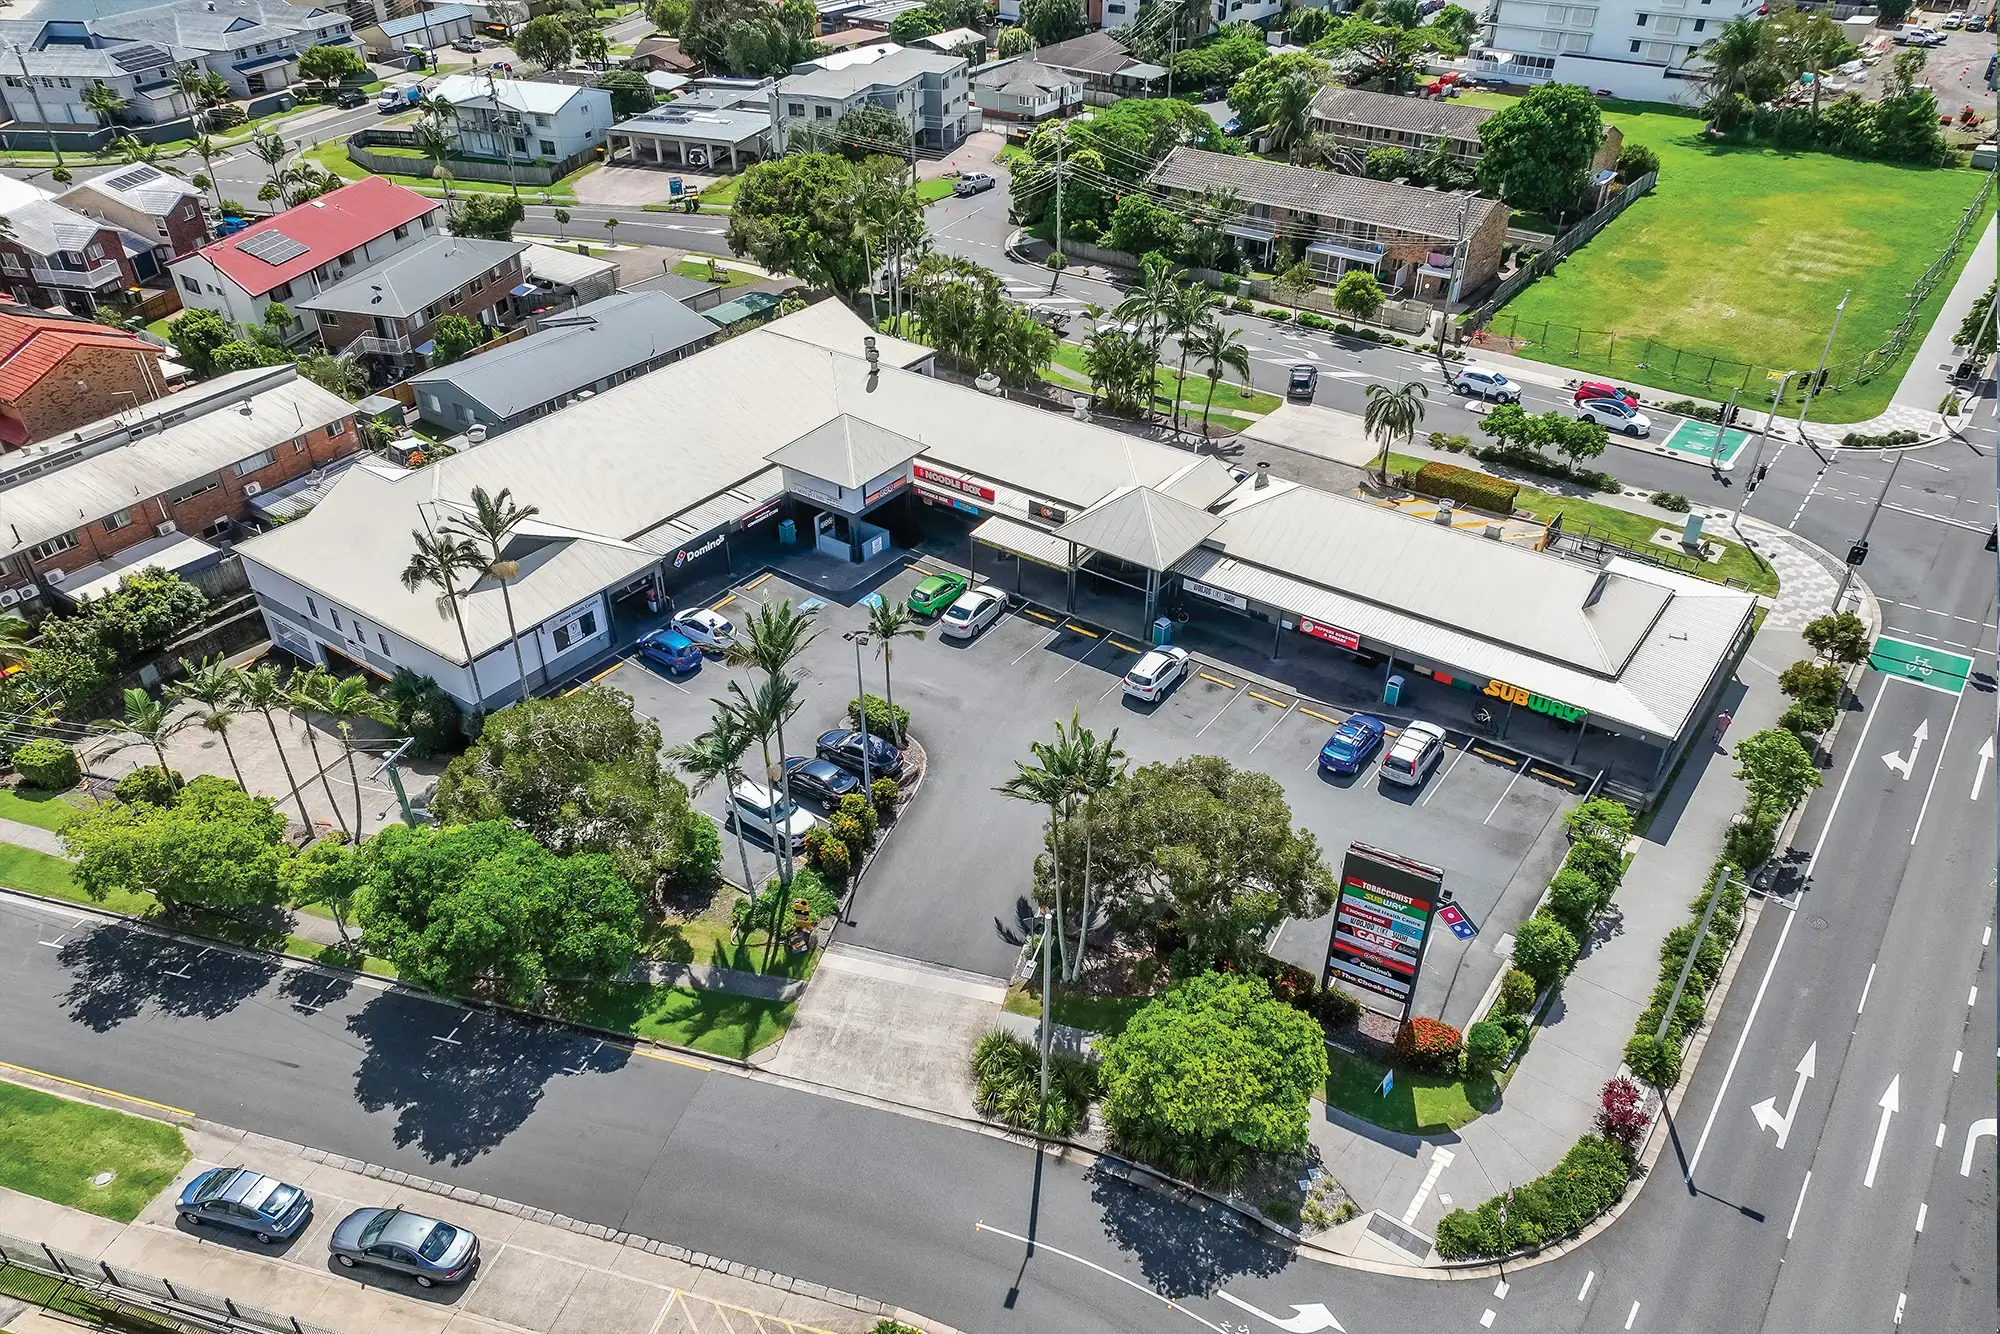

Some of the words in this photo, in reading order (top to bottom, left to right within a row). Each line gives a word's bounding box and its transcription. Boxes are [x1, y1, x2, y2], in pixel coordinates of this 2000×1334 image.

[925, 471, 961, 489] NOODLE
[962, 483, 982, 496] BOX
[571, 605, 586, 616] Health
[1483, 680, 1588, 723] SUBWAY
[1362, 881, 1413, 905] TOBACCONIST
[1363, 893, 1407, 911] SUBWAY
[1349, 908, 1373, 920] NOODLE
[1373, 916, 1386, 925] BOX
[1364, 904, 1380, 913] Allied
[1381, 909, 1400, 920] Health
[1401, 915, 1421, 927] Centre
[1357, 930, 1394, 949] CAFE
[1376, 926, 1389, 936] LIKE
[1391, 931, 1409, 943] SUSHI
[1359, 961, 1392, 978] Domino's
[1341, 971, 1356, 981] The
[1357, 978, 1383, 991] Chook
[1384, 988, 1405, 1000] Shop
